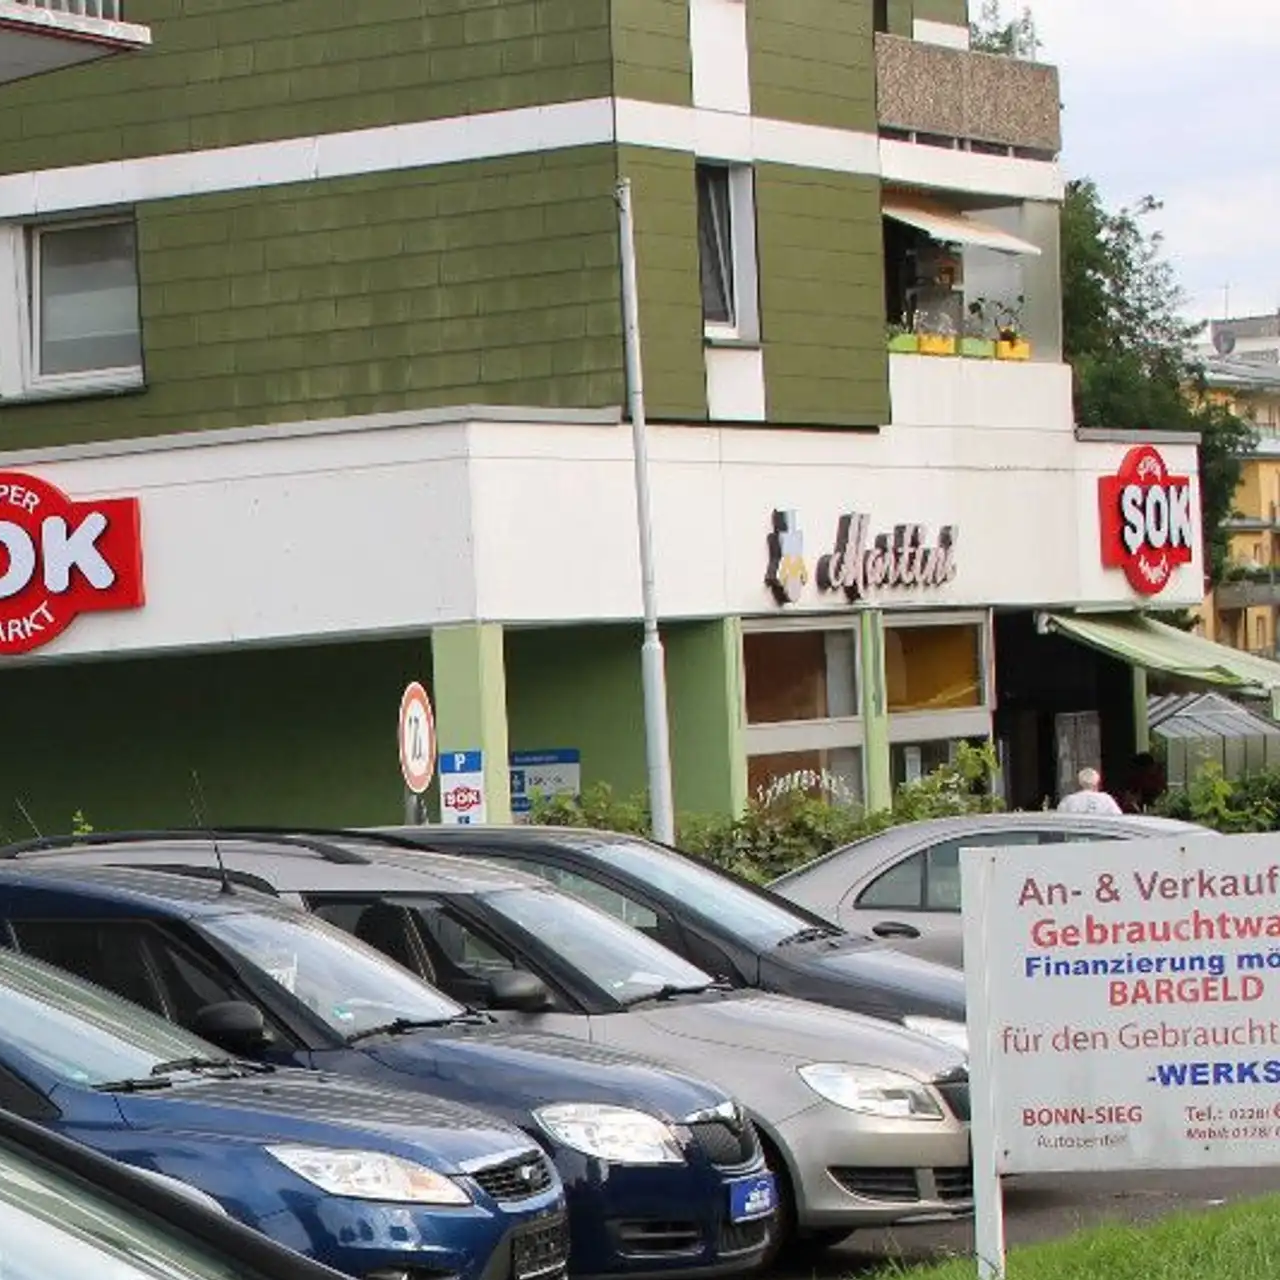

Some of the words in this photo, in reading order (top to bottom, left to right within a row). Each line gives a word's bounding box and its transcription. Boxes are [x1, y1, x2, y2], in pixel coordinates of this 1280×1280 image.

[1018, 877, 1082, 907] An-
[1095, 873, 1121, 903] &
[1133, 865, 1280, 902] Verkauf
[1025, 952, 1225, 978] Finanzierung
[1109, 974, 1264, 1007] BARGELD
[1002, 1026, 1043, 1055] für
[1052, 1025, 1109, 1052] den
[1022, 1106, 1142, 1127] BONN-SIEG
